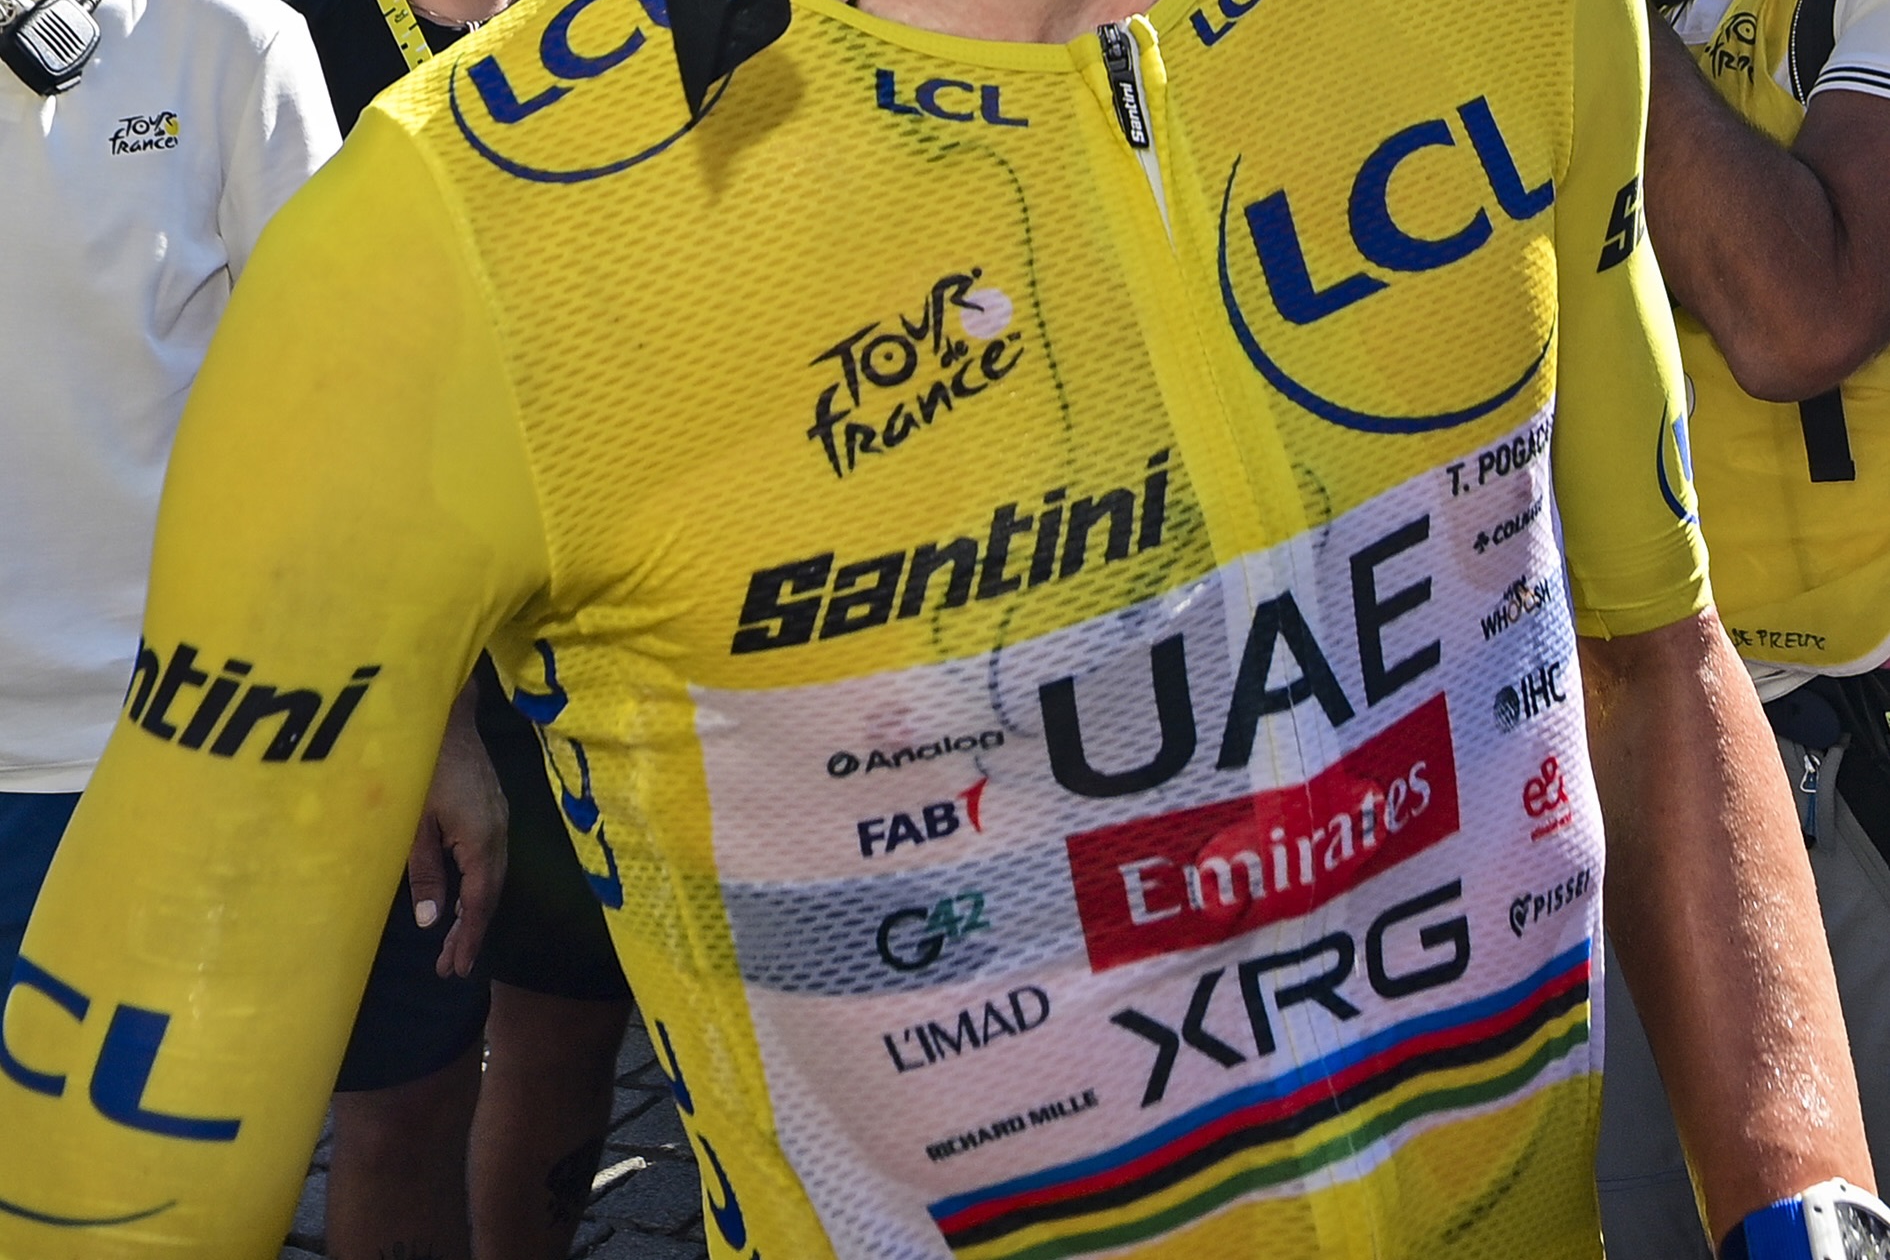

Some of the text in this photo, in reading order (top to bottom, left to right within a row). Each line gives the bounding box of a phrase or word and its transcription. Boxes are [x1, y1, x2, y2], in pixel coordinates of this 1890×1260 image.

[875, 69, 1029, 128] LCL
[1119, 81, 1146, 144] Santini
[1244, 94, 1554, 326] LCL
[730, 448, 1170, 655] Santini
[123, 636, 382, 763] ntini
[1038, 513, 1442, 799] UAE
[1521, 661, 1567, 720] IHC
[857, 801, 961, 857] FAB
[1117, 760, 1432, 927] Emirates
[875, 891, 992, 972] G42
[1532, 868, 1592, 923] PISSEI
[883, 985, 1051, 1074] L'IMAD
[1109, 878, 1471, 1109] XRG
[0, 953, 242, 1143] CL
[926, 1088, 1099, 1163] RICHARD MILLE
